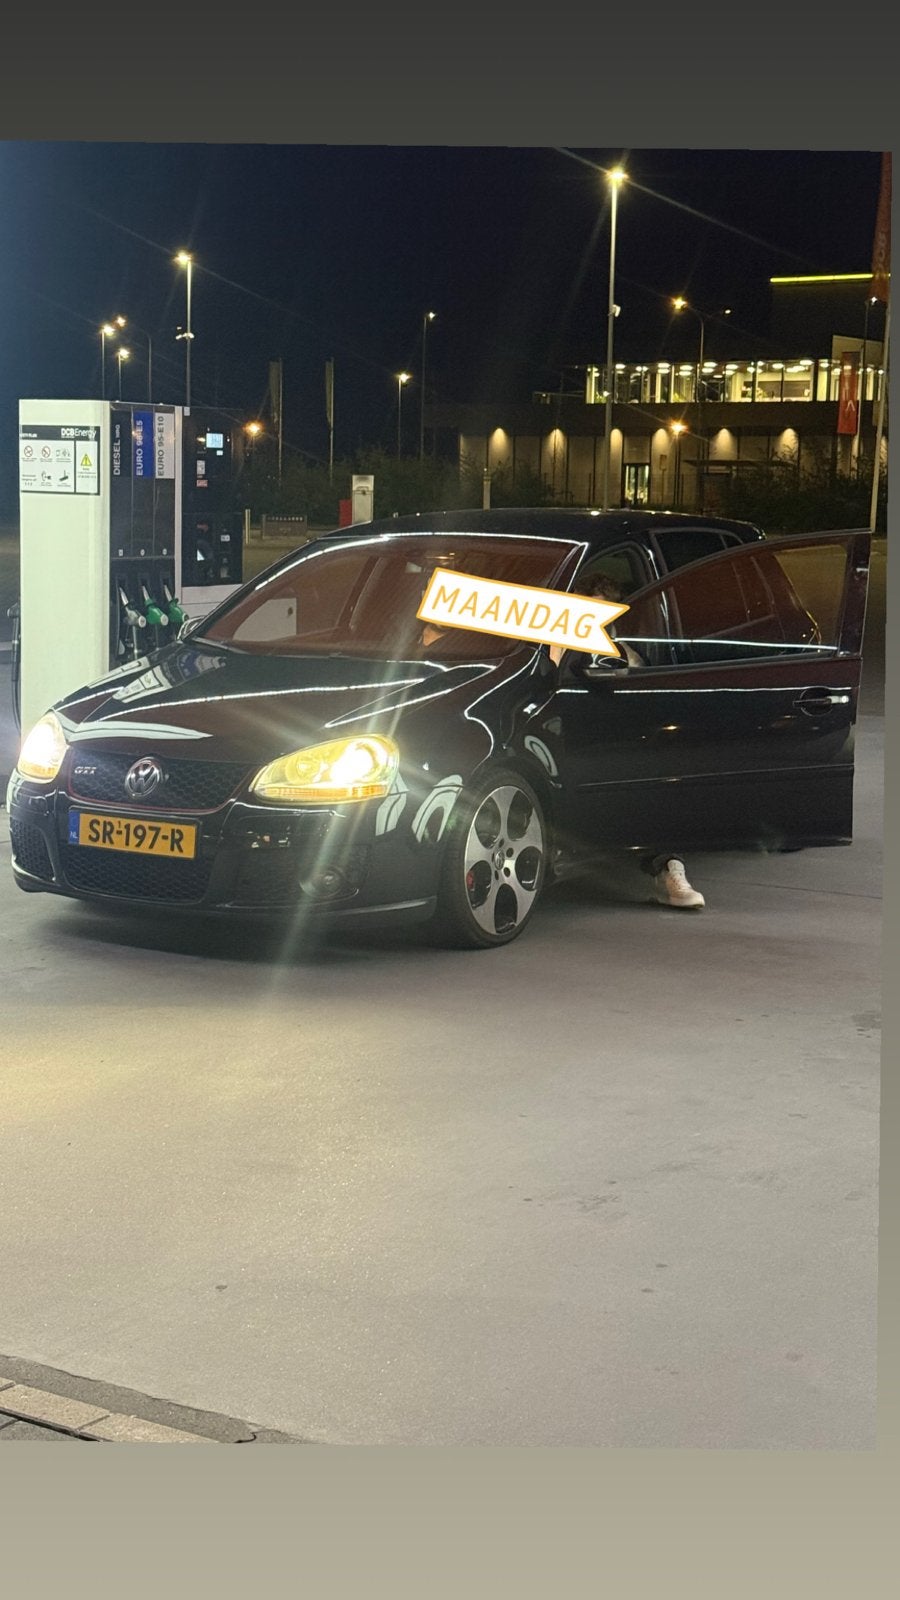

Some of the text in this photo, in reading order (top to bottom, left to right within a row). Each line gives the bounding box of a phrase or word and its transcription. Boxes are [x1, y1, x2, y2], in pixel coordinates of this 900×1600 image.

[113, 439, 121, 476] DIESEL
[135, 448, 144, 476] EURO
[157, 416, 165, 477] EURO 95-E10
[74, 766, 97, 775] GTI
[70, 831, 78, 839] NL
[88, 818, 184, 854] SR-197-R
